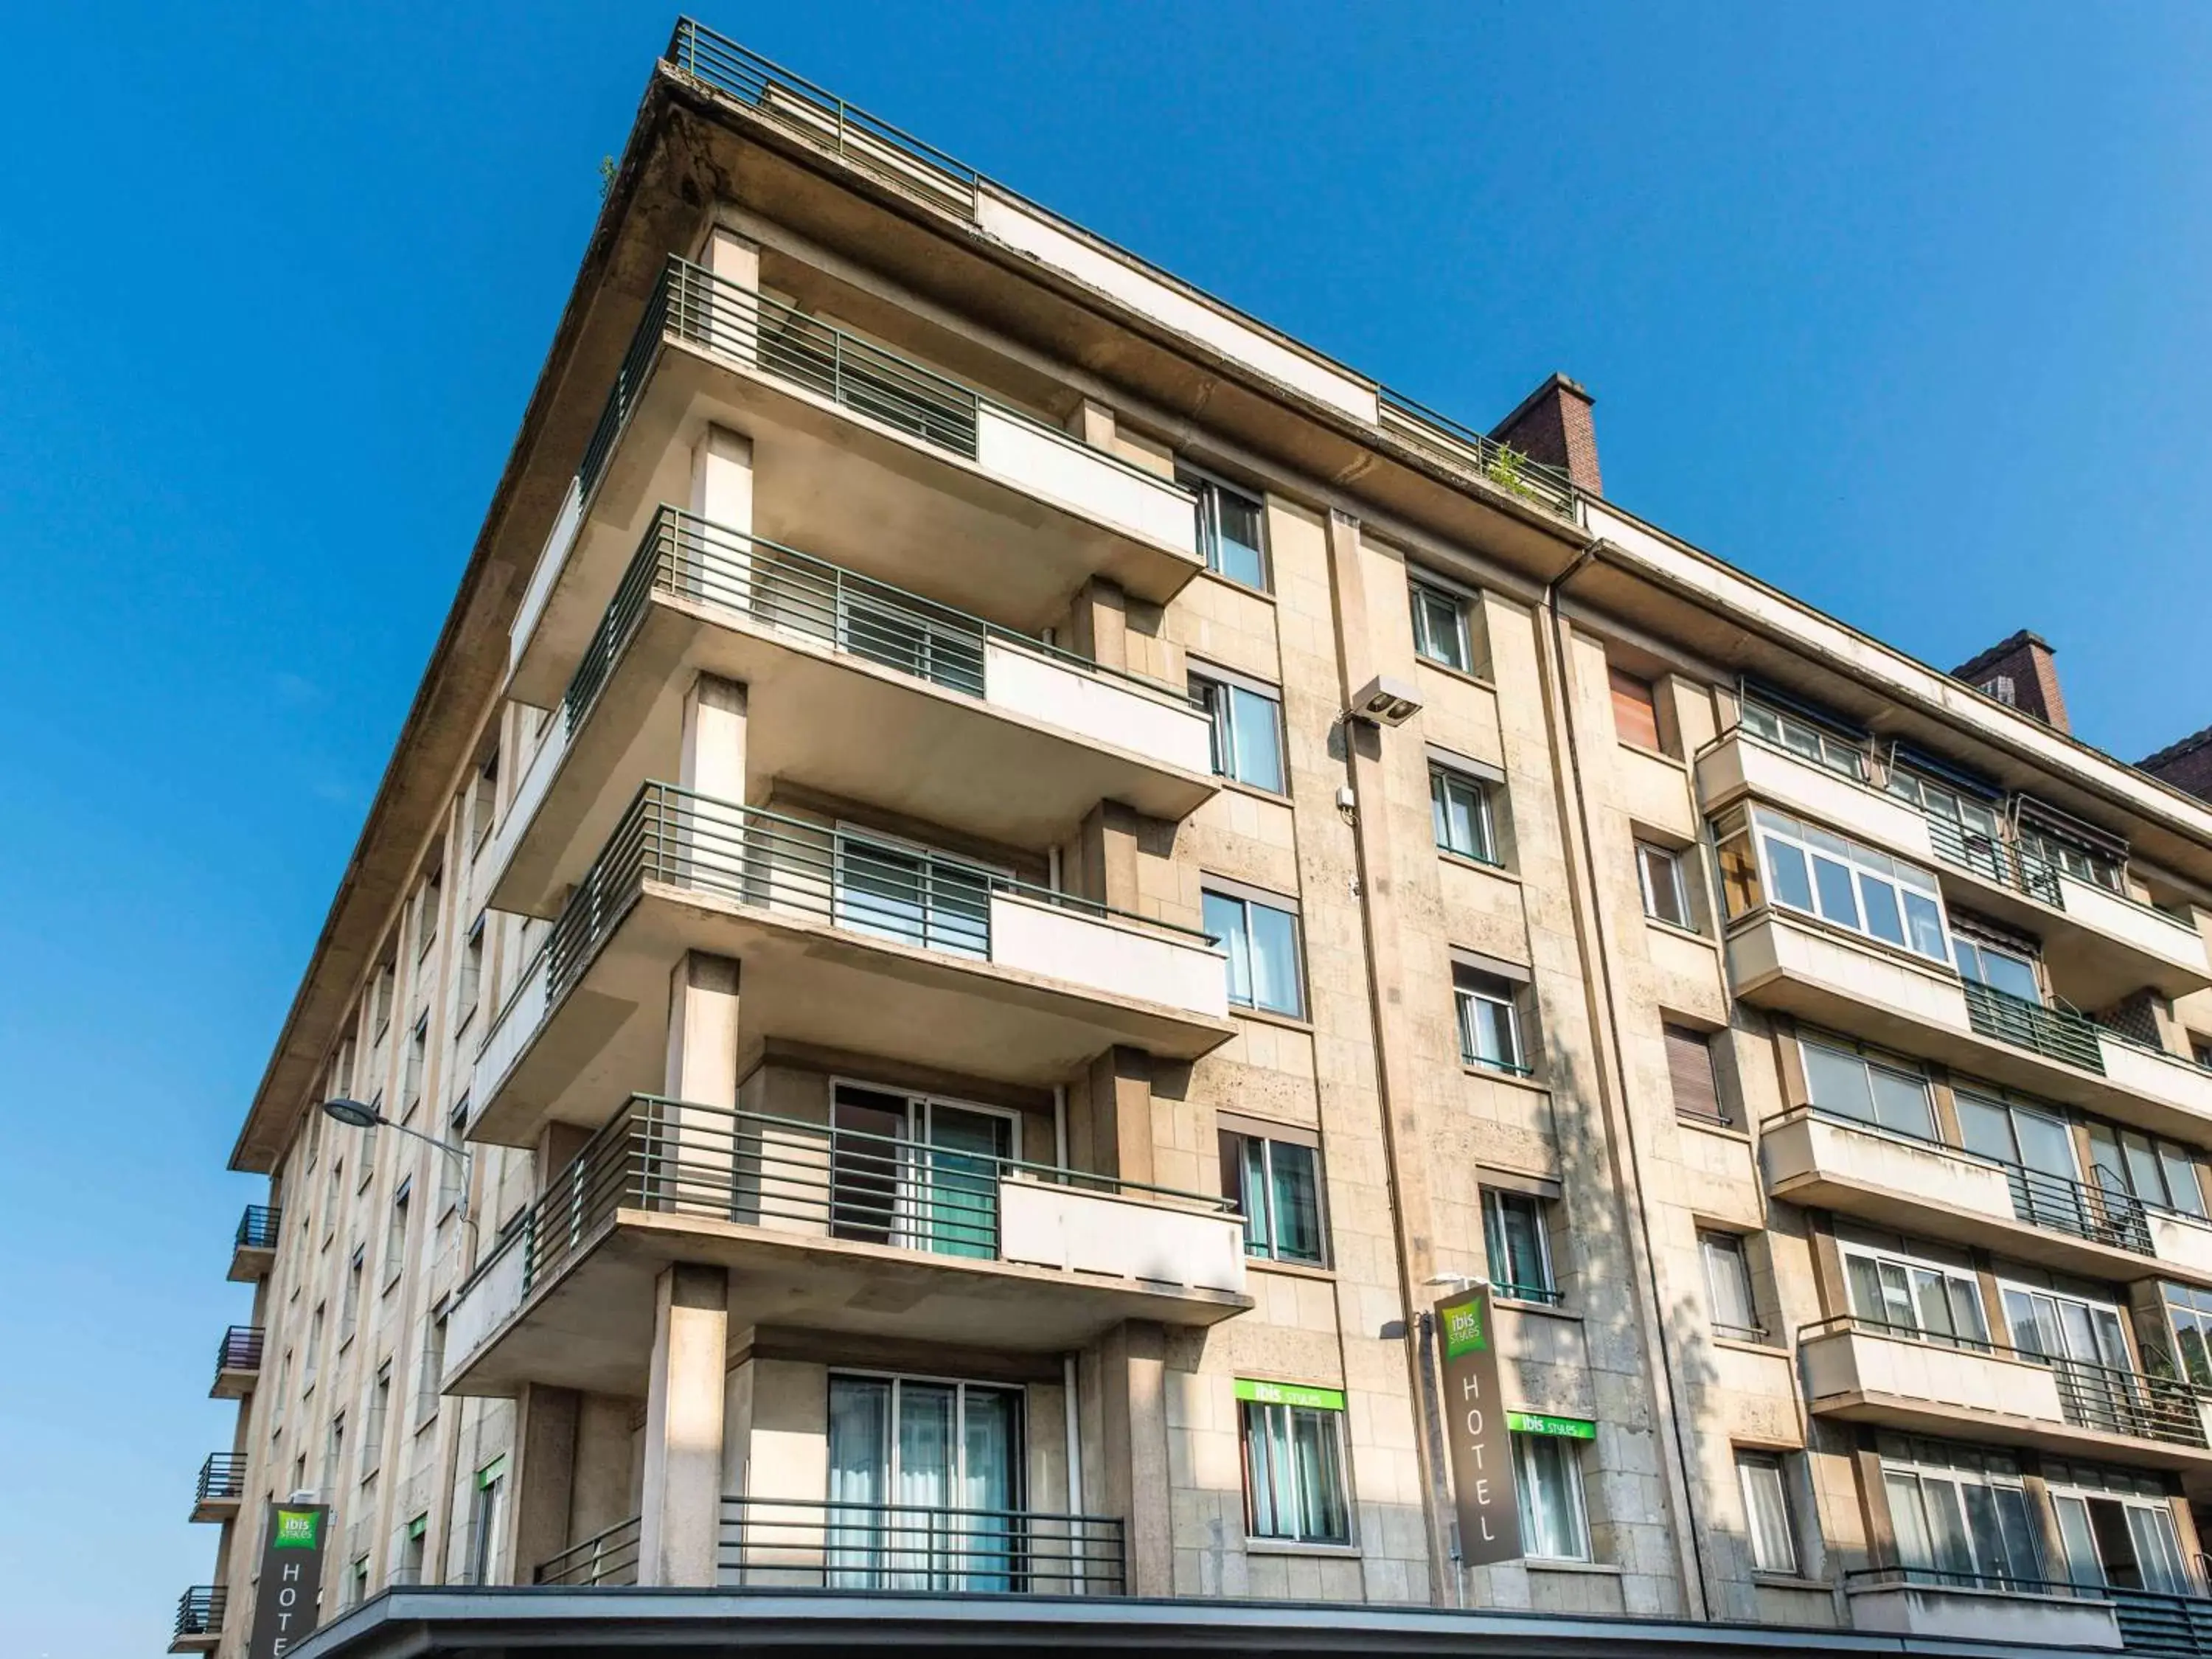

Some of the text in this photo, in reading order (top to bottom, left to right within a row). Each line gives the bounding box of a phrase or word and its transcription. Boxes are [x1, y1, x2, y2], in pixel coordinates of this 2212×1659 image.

[1451, 1311, 1475, 1332] ibis
[1254, 1382, 1281, 1402] ibis
[1523, 1414, 1545, 1432] ibis
[1464, 1374, 1495, 1542] HOTEL
[285, 1517, 309, 1530] ibis
